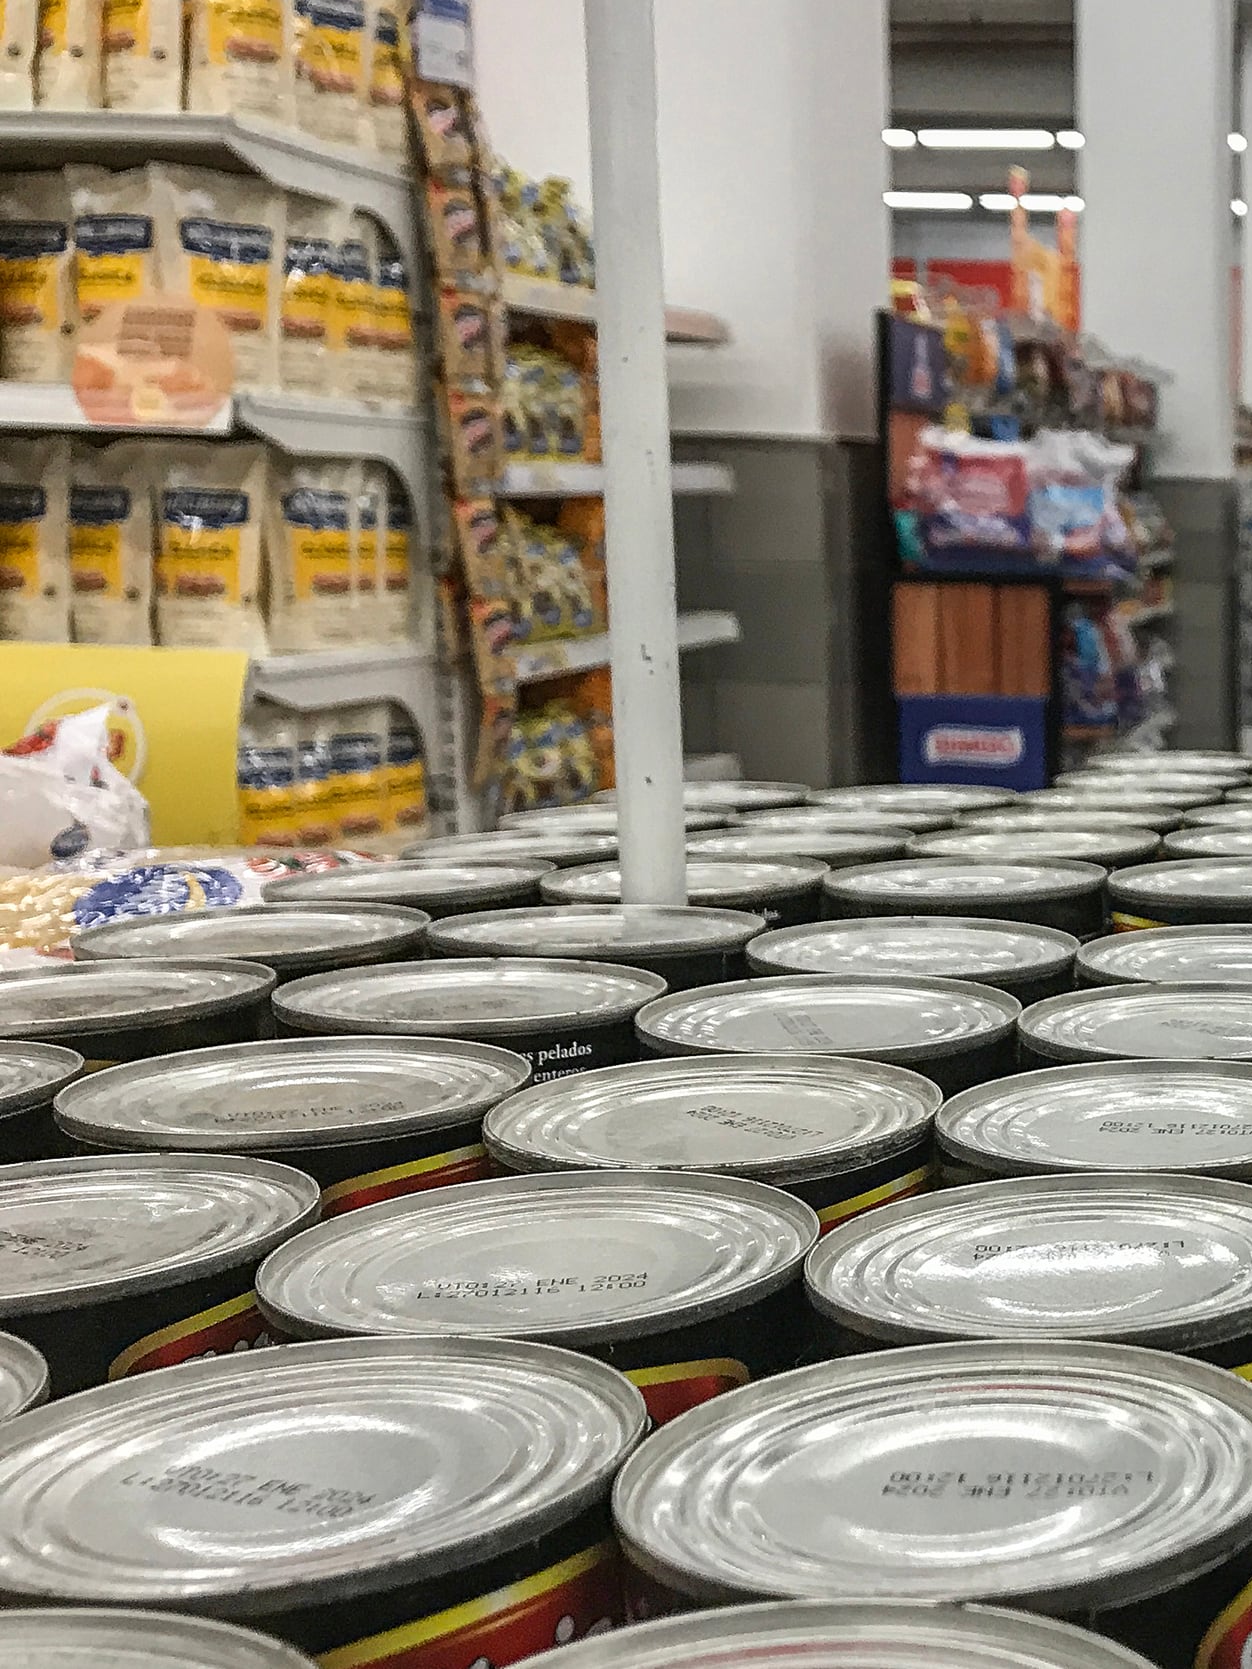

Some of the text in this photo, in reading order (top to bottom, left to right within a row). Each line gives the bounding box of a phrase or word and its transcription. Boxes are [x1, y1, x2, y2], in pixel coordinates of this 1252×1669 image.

[538, 1041, 593, 1066] pelados
[536, 1276, 580, 1287] ENE
[594, 1272, 648, 1283] 2024
[417, 1280, 647, 1299] L:27012116 12:00
